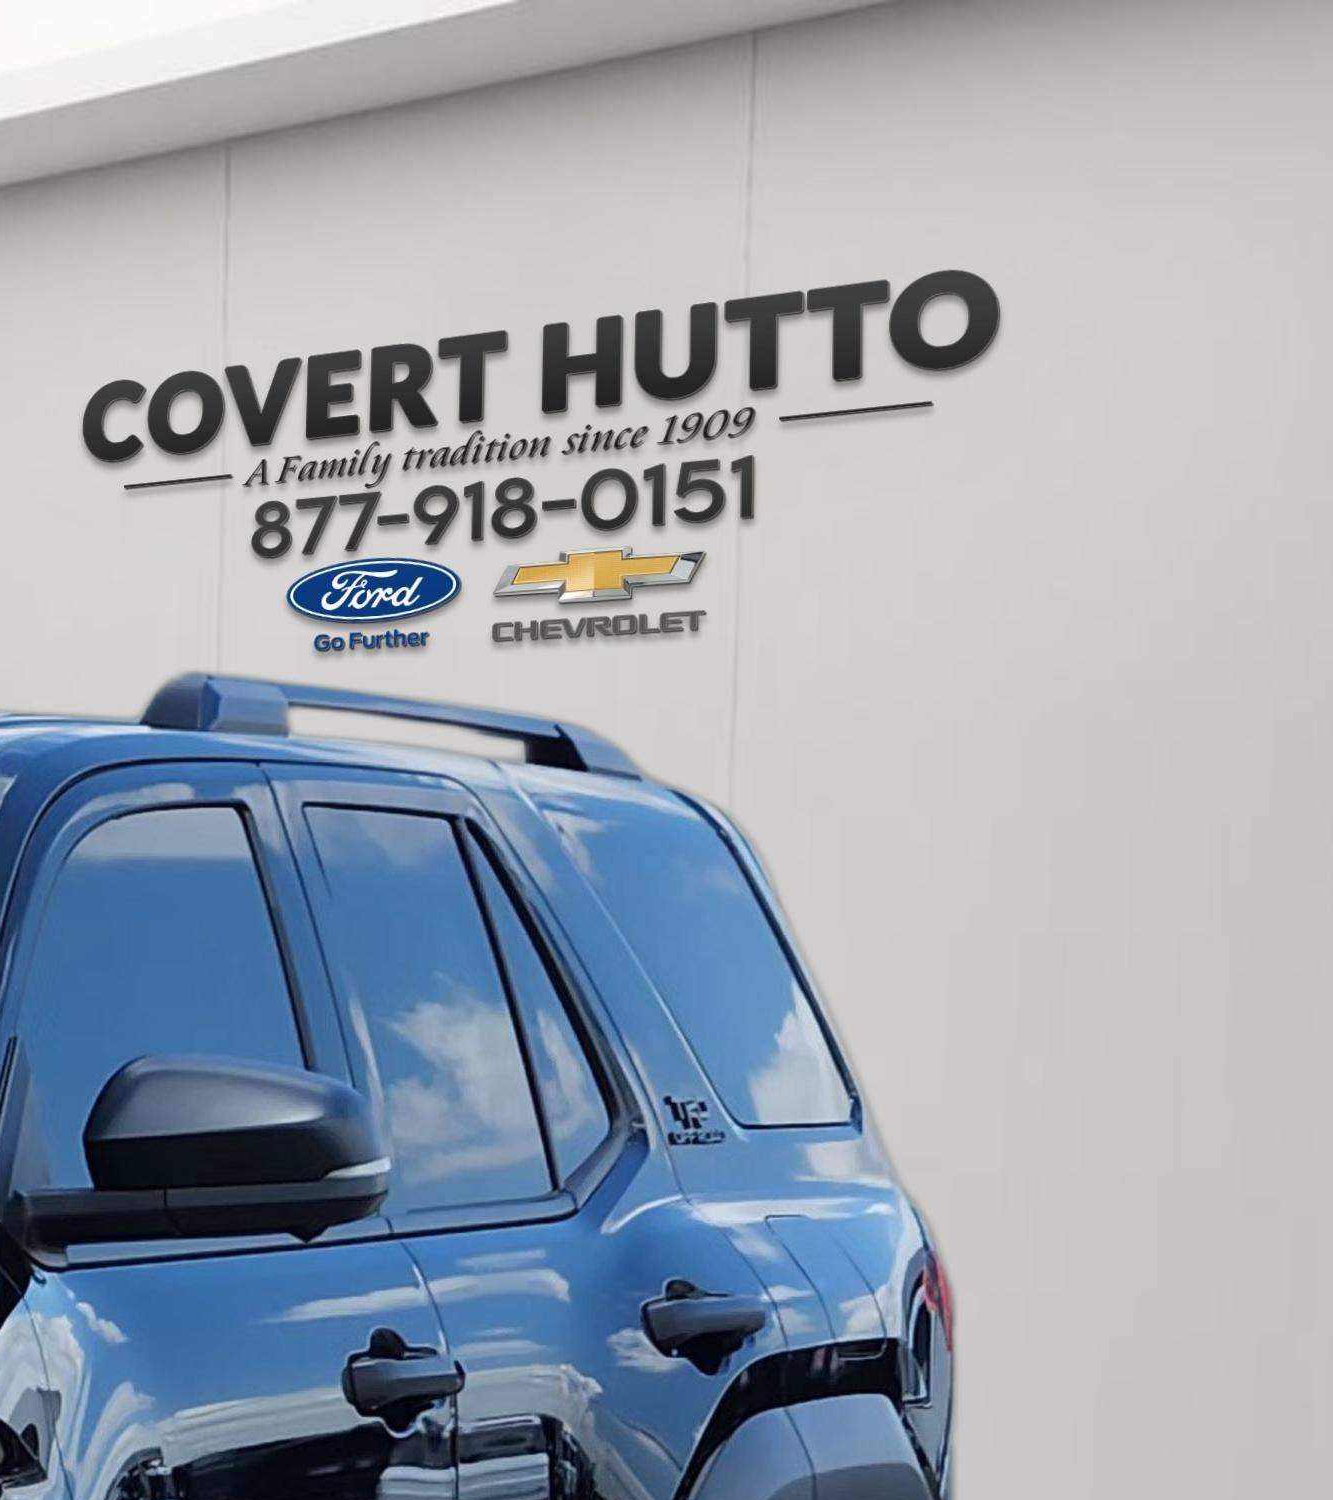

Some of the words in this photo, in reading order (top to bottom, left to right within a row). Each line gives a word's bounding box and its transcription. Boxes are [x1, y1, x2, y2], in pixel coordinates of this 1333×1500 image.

[82, 330, 508, 463] COVERT
[541, 269, 1001, 414] HUTTO
[244, 459, 269, 488] A
[275, 441, 393, 488] Family
[403, 430, 551, 470] tradition
[561, 421, 650, 456] since
[656, 406, 757, 447] 1909
[251, 454, 756, 559] 877-918-0151
[320, 569, 423, 611] Ford
[313, 633, 347, 653] Go
[349, 628, 430, 650] Further
[491, 610, 707, 643] CHEVROLET
